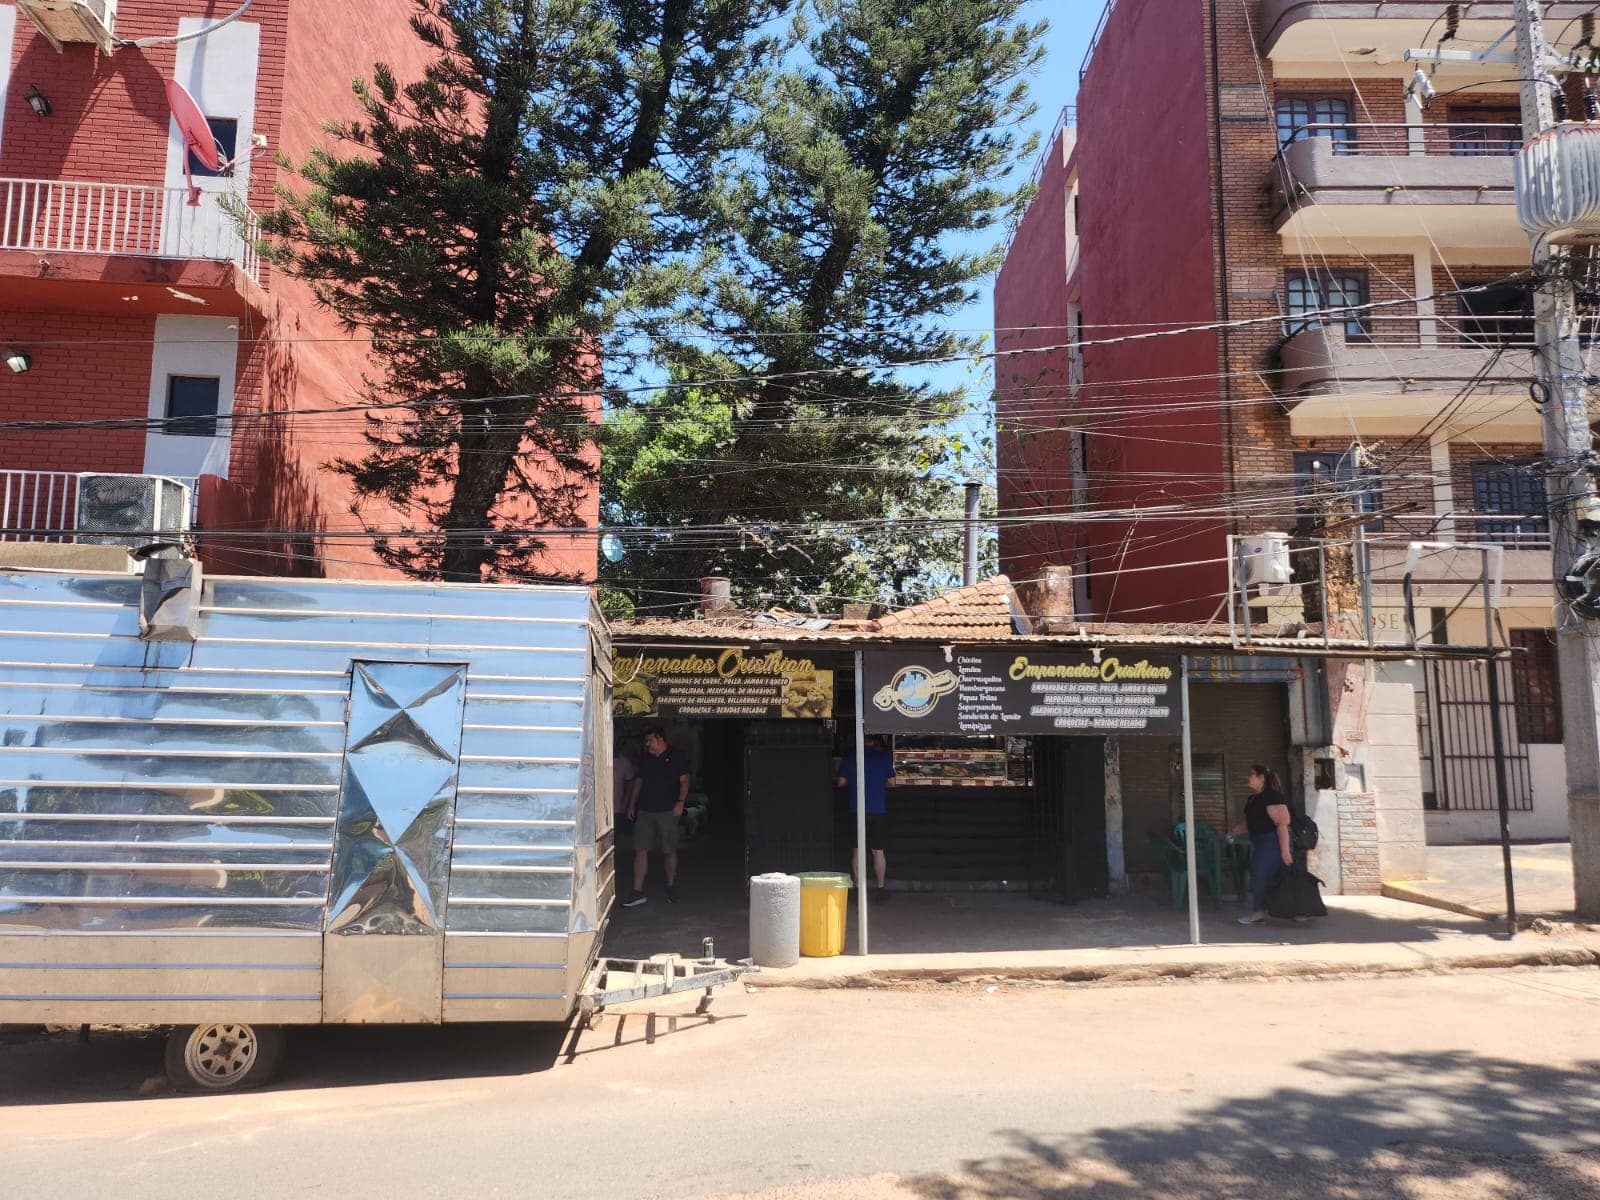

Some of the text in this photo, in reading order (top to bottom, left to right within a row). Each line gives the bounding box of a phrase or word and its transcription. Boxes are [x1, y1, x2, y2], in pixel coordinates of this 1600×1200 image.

[611, 648, 717, 675] mpanadas
[1009, 656, 1099, 680] Empanadas
[959, 693, 978, 703] Papas
